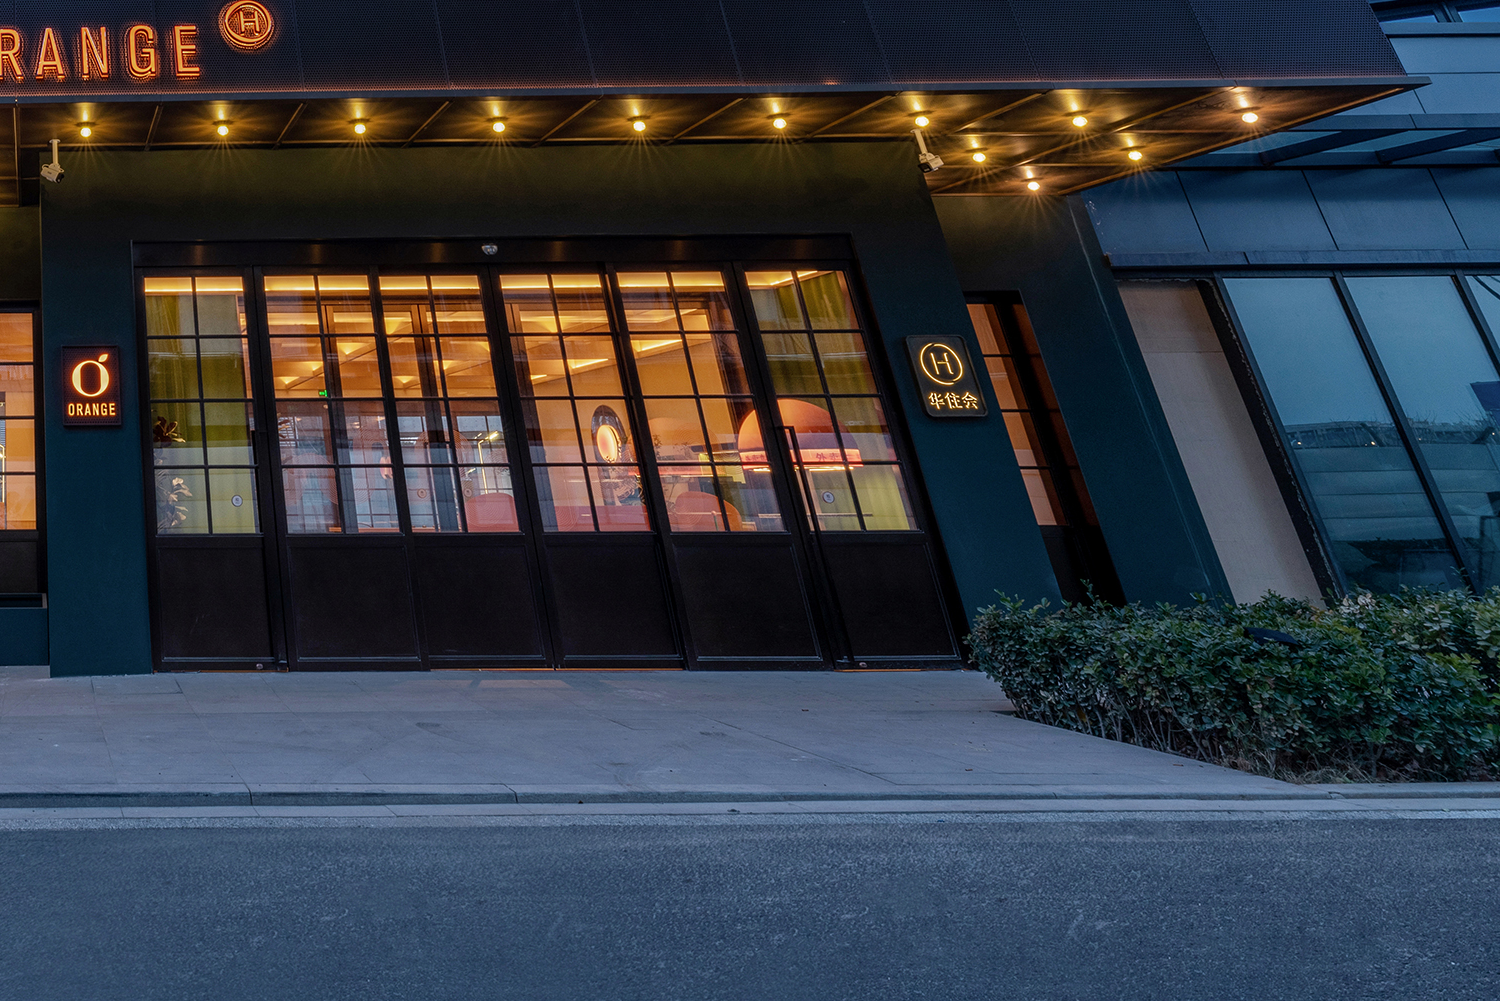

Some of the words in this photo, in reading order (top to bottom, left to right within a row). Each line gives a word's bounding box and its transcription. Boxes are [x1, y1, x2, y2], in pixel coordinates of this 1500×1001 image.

[928, 391, 979, 410] 华住会
[67, 402, 117, 417] ORANGE
